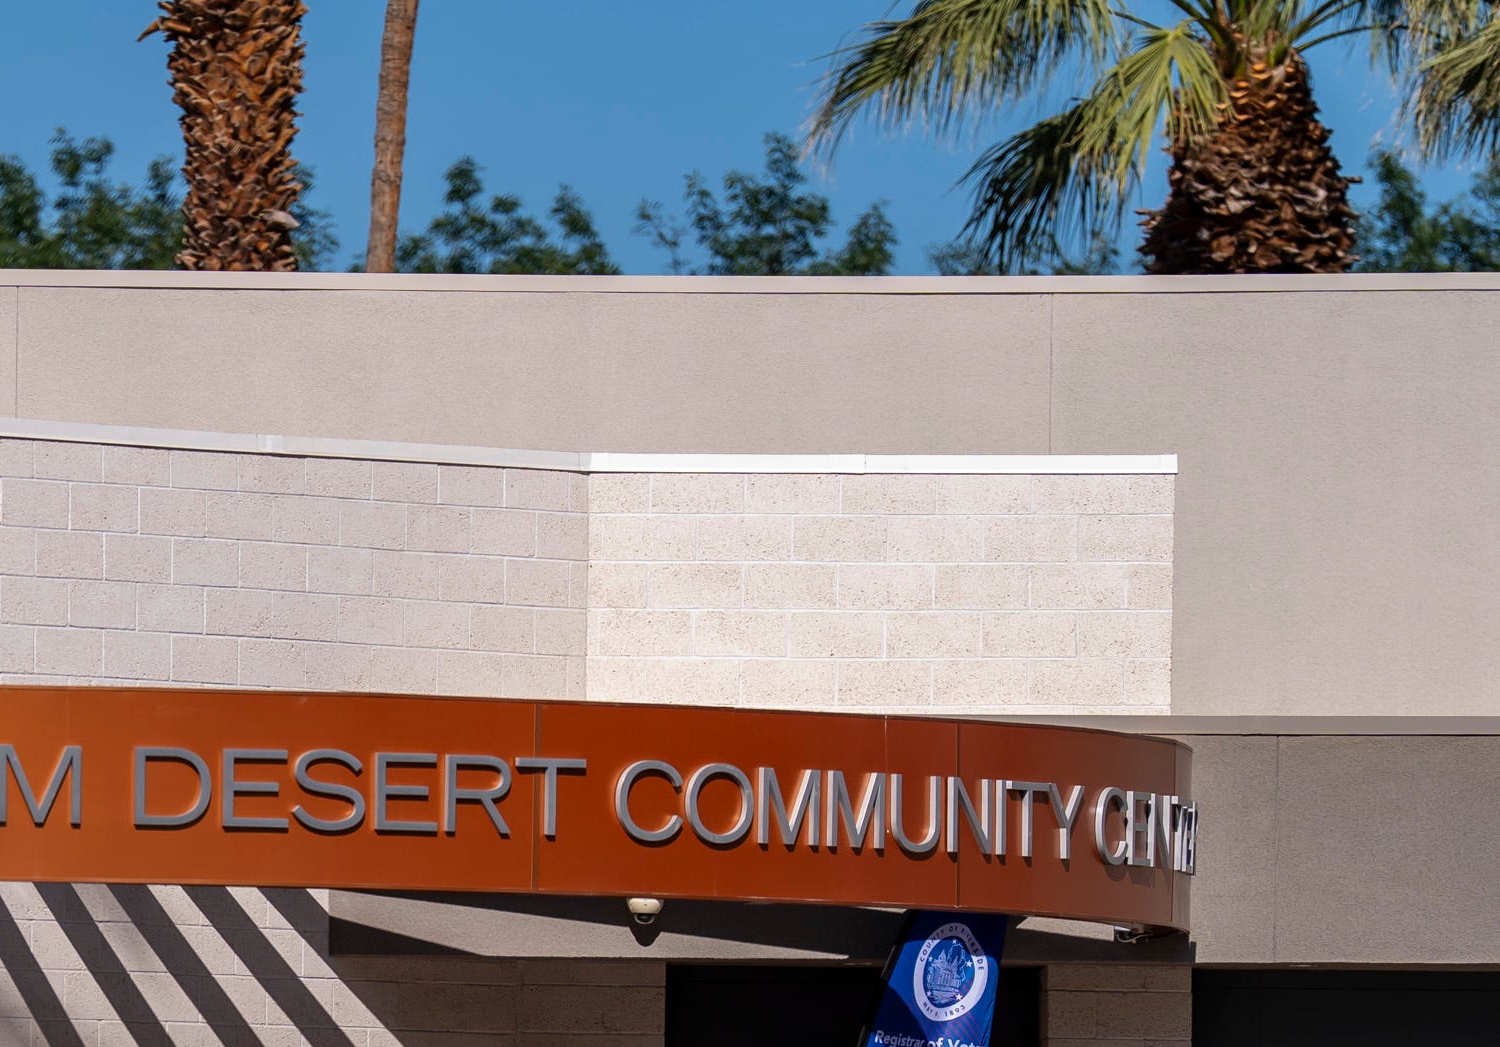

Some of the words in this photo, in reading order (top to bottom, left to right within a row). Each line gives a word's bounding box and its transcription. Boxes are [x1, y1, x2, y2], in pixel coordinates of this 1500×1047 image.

[133, 746, 587, 839] DESERT
[615, 759, 1086, 861] COMMUNITY
[944, 1004, 966, 1017] 1893
